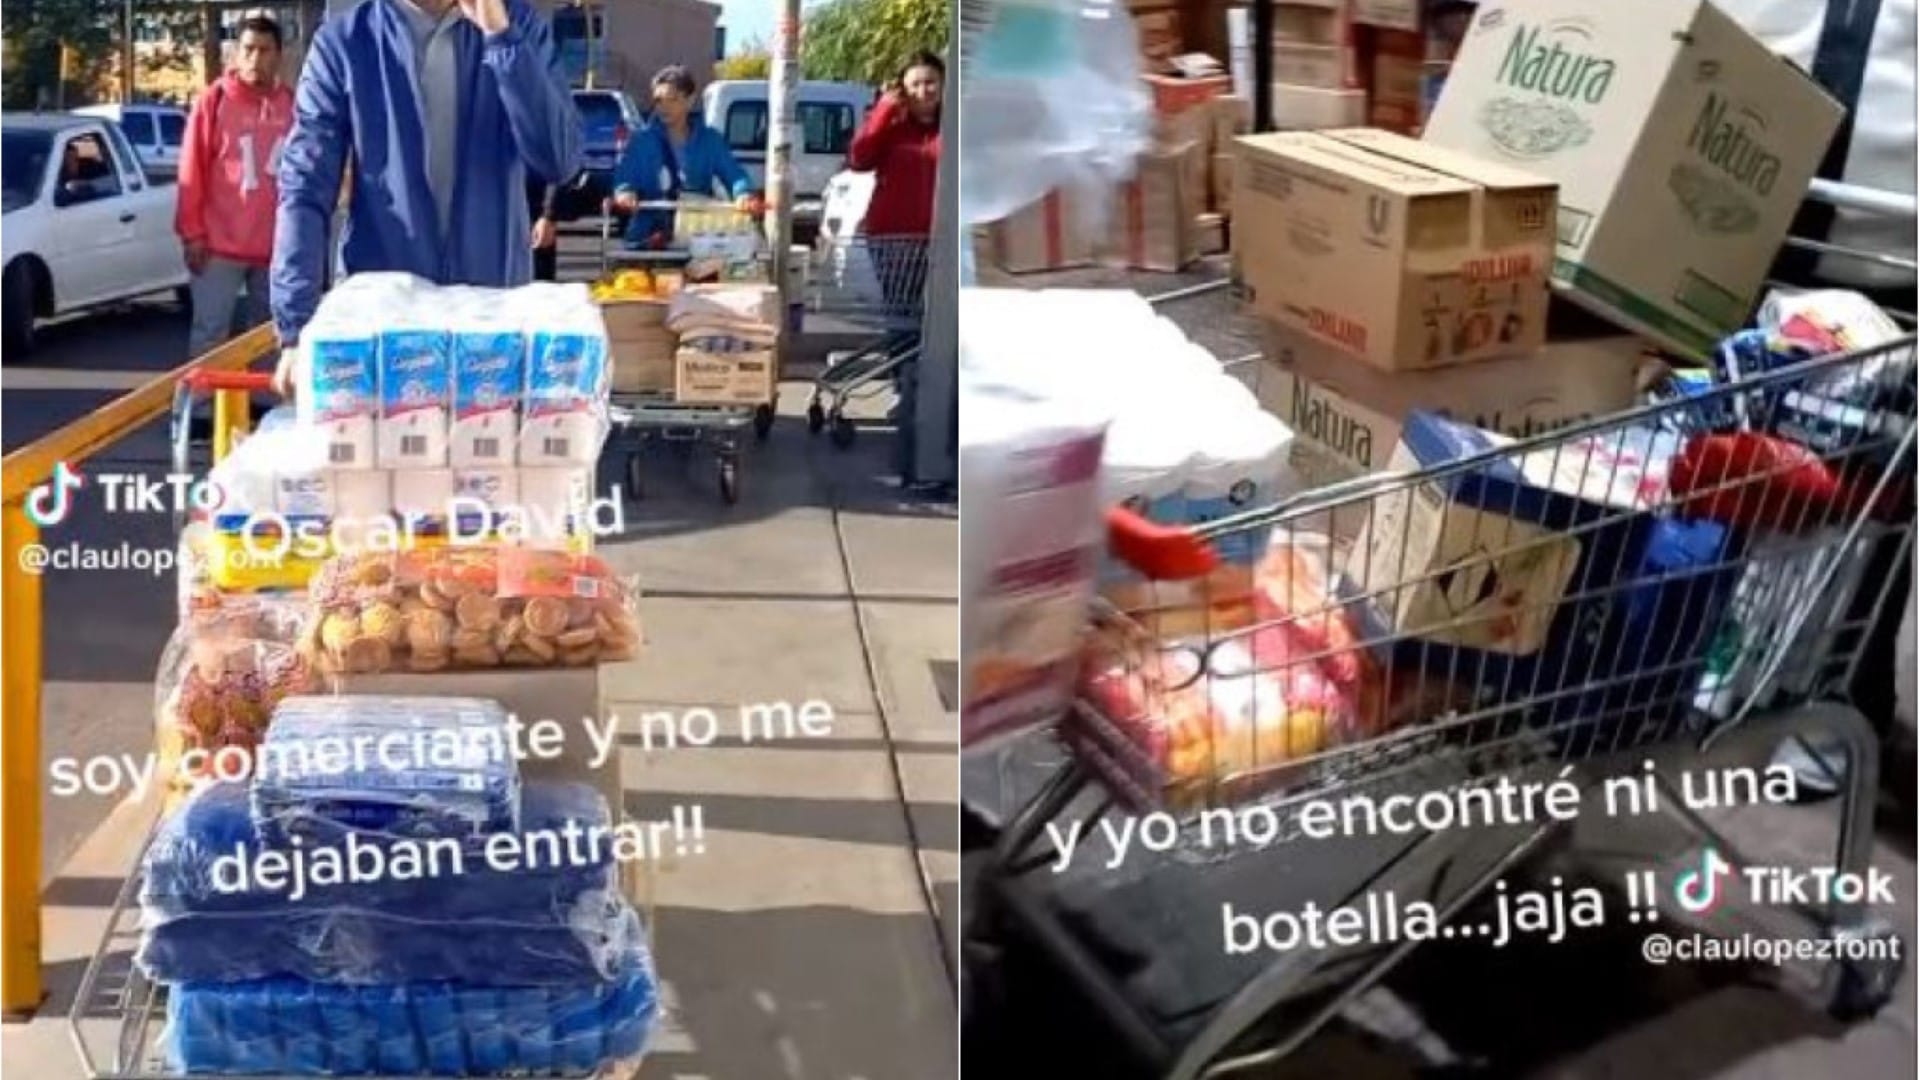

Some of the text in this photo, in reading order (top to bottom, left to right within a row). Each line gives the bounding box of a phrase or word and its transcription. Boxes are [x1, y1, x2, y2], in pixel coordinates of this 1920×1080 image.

[1496, 24, 1617, 104] Natura
[1688, 93, 1782, 197] Natura
[1292, 374, 1373, 467] Natura
